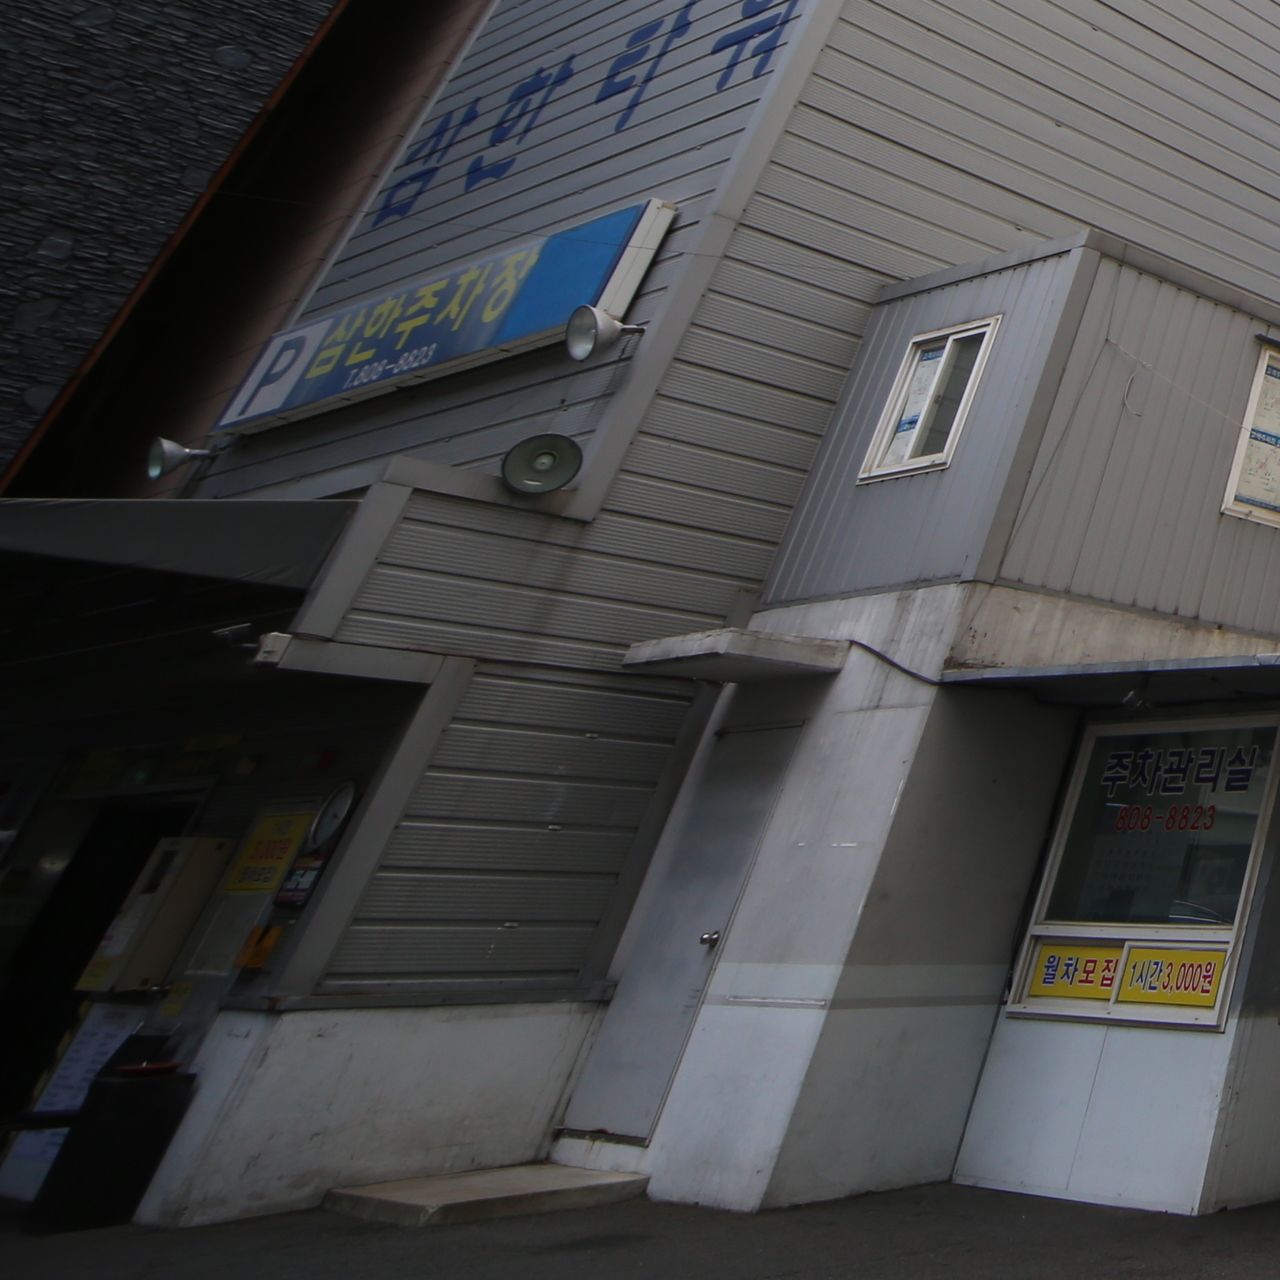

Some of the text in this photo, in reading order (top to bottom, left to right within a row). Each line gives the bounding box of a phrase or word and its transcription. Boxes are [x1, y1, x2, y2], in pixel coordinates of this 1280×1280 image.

[305, 246, 540, 379] 삼한주차장
[239, 333, 306, 416] P
[1101, 745, 1261, 798] 주차관리실
[1113, 803, 1217, 833] 808-8823
[1163, 961, 1216, 995] 3,000원
